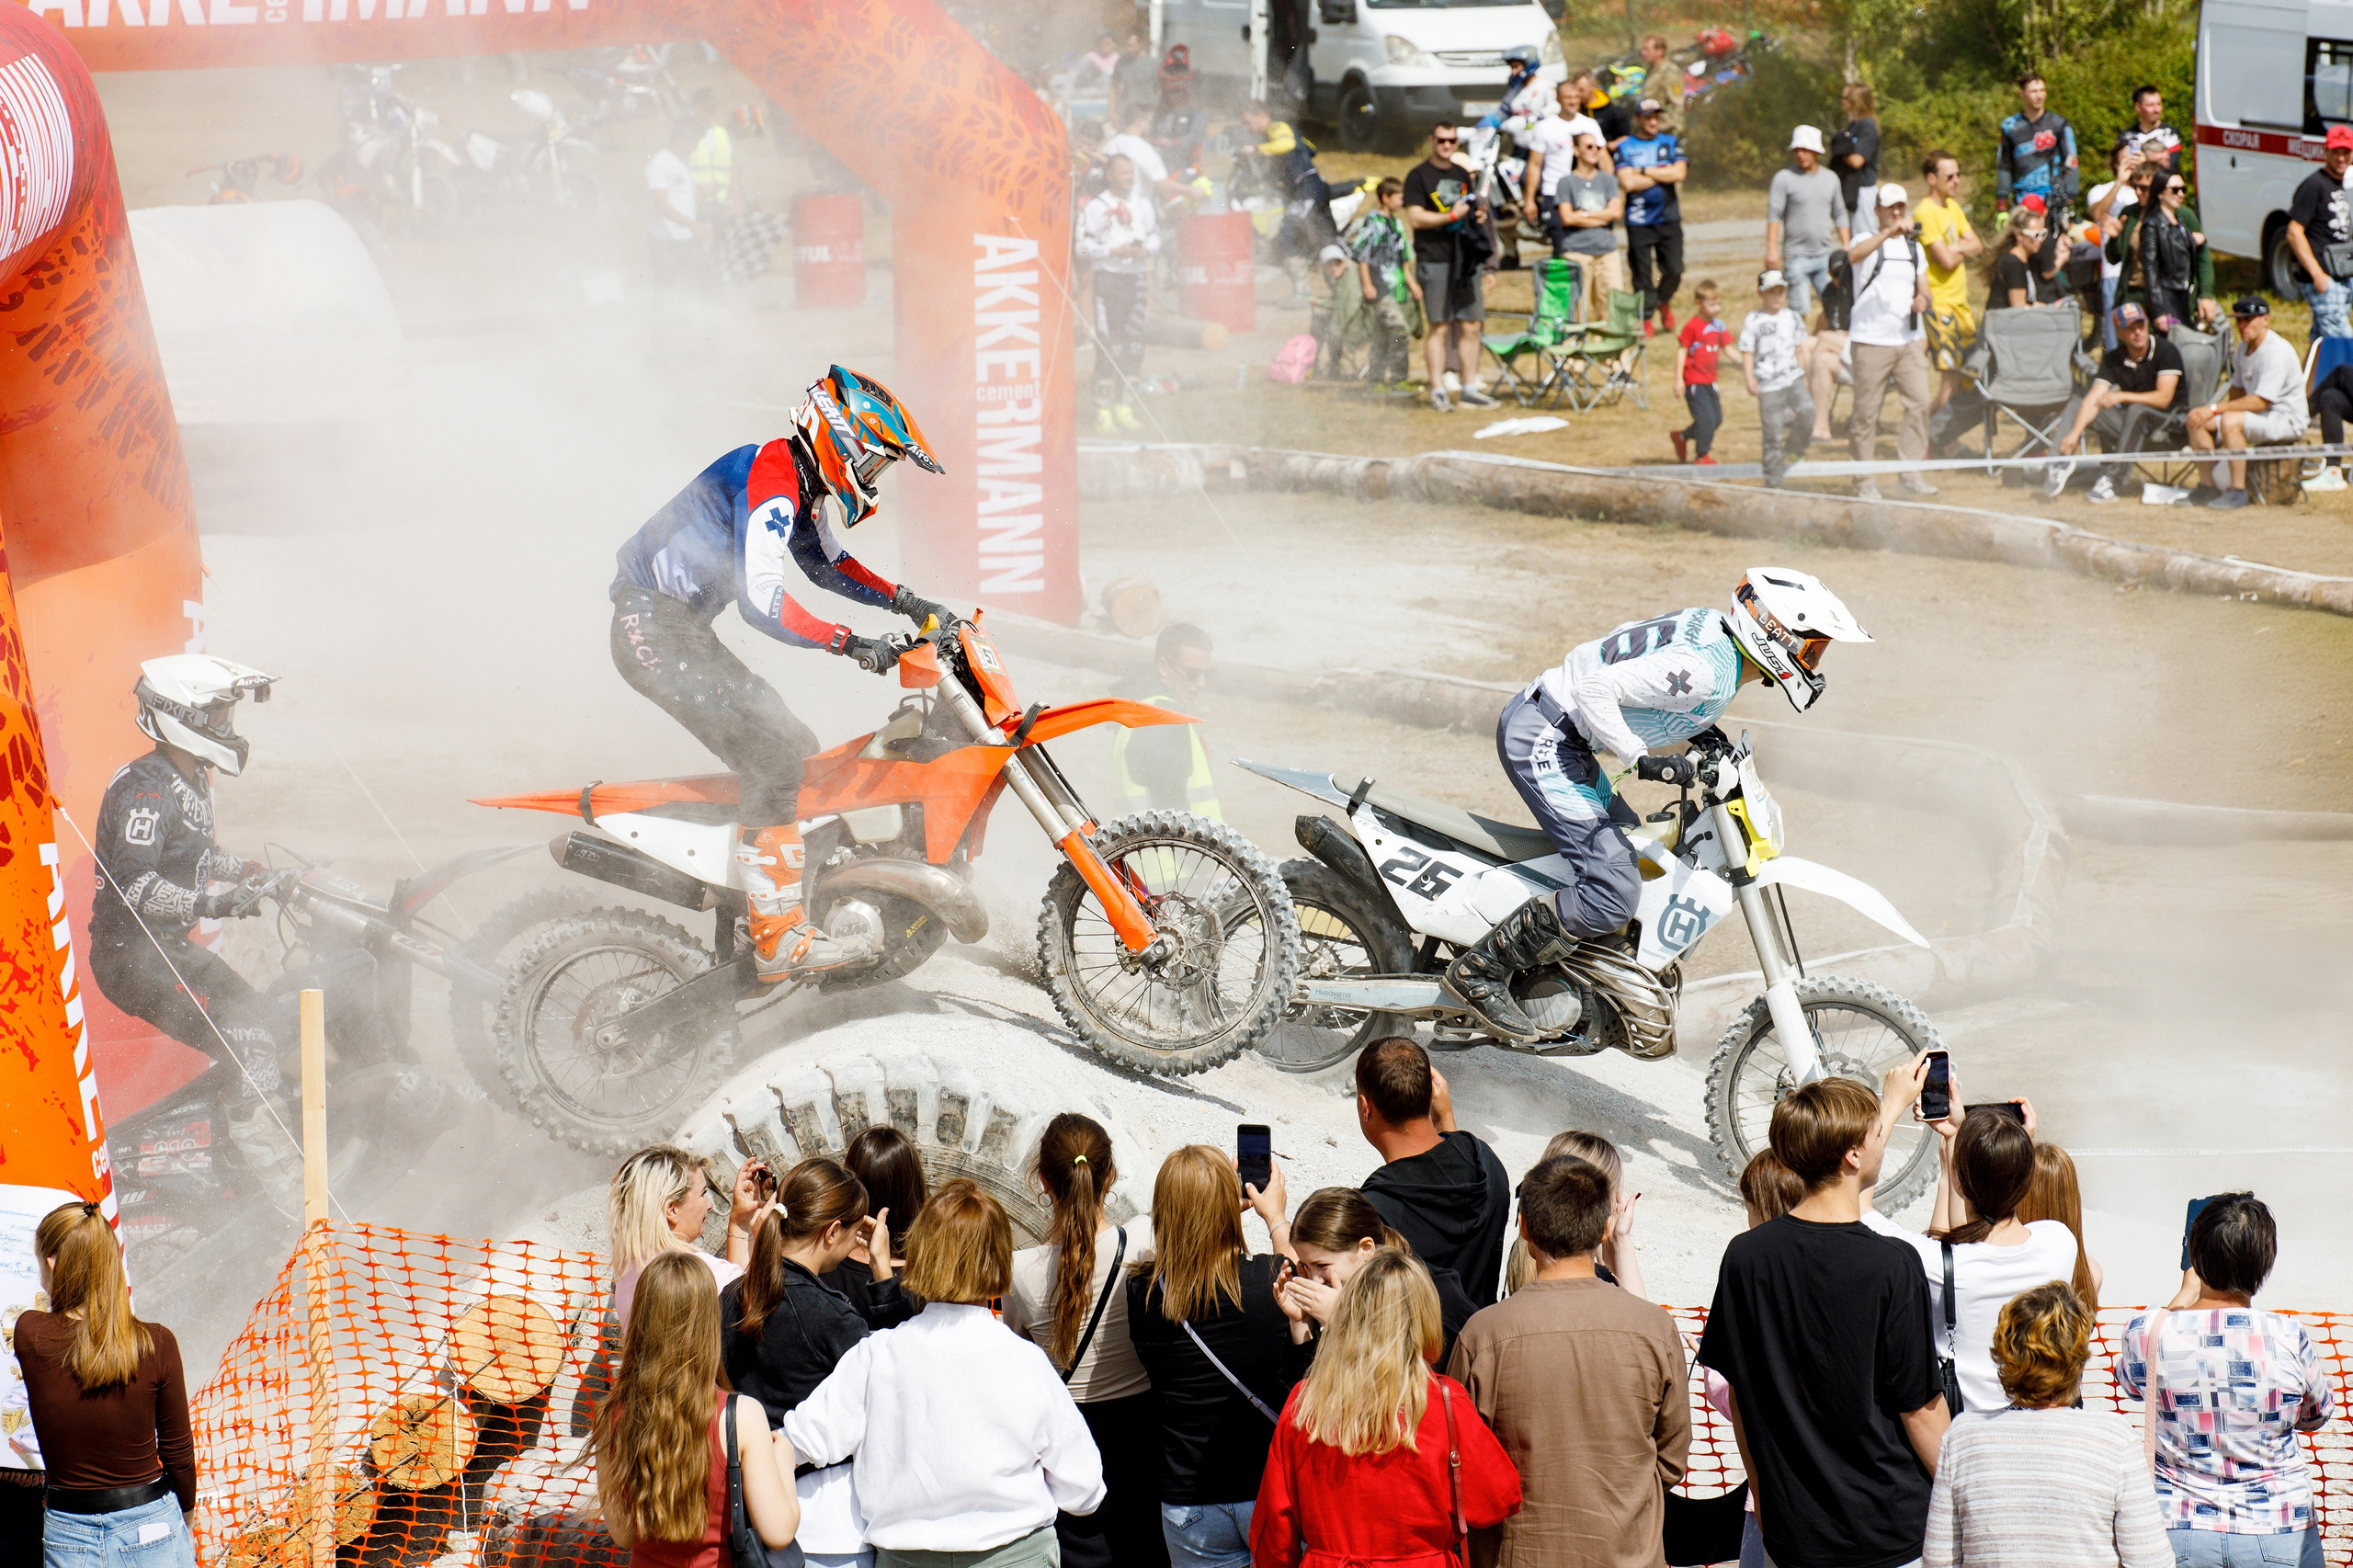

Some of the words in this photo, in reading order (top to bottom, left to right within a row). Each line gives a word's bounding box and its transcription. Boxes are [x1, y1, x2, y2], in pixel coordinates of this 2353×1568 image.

[975, 379, 1041, 402] cement
[813, 391, 857, 438] LEATT
[973, 233, 1045, 594] AKKERMANN
[1600, 609, 1686, 665] 6
[1758, 611, 1798, 648] LEATT
[982, 647, 997, 667] 57
[151, 694, 198, 726] FXR
[1378, 846, 1465, 902] 26
[835, 922, 869, 938] KTM
[1641, 947, 1666, 961] Husqvarna
[1315, 988, 1351, 998] Husqvarna
